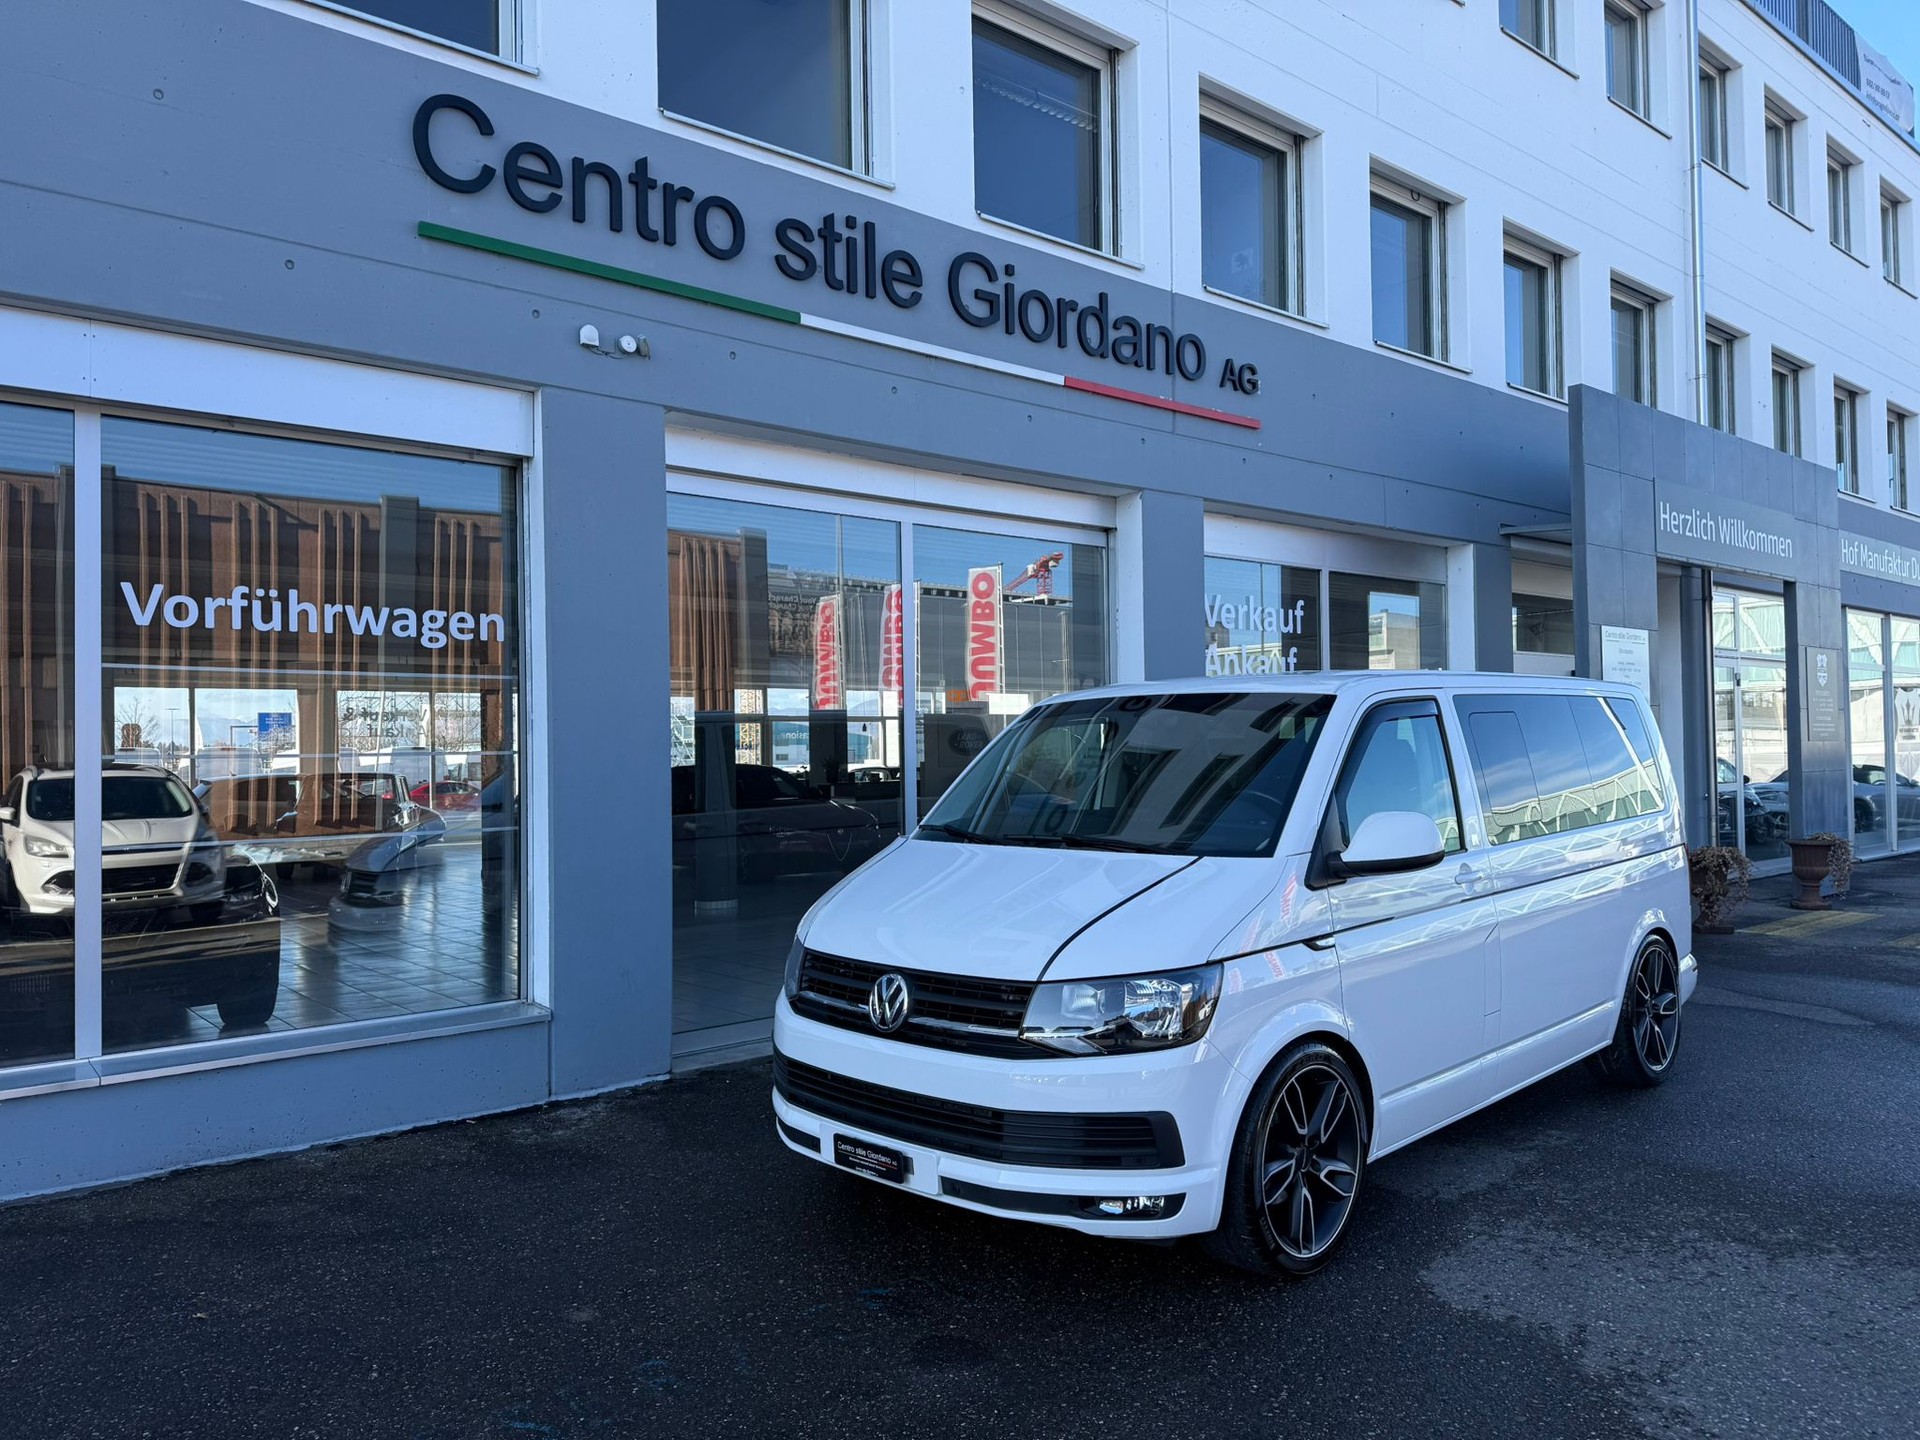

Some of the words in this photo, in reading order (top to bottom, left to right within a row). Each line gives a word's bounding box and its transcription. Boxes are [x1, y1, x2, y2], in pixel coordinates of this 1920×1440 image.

[412, 93, 746, 261] Centro
[774, 212, 923, 309] stile
[947, 251, 1207, 382] Giordano
[1219, 358, 1260, 396] AG
[1659, 501, 1716, 543] Herzlich
[1718, 516, 1793, 559] Willkommen
[1841, 538, 1859, 567] Hof
[1860, 543, 1910, 579] Manufaktur
[119, 581, 505, 649] Vorführwagen
[1204, 594, 1305, 634] Verkauf
[1205, 643, 1298, 677] Ankauf
